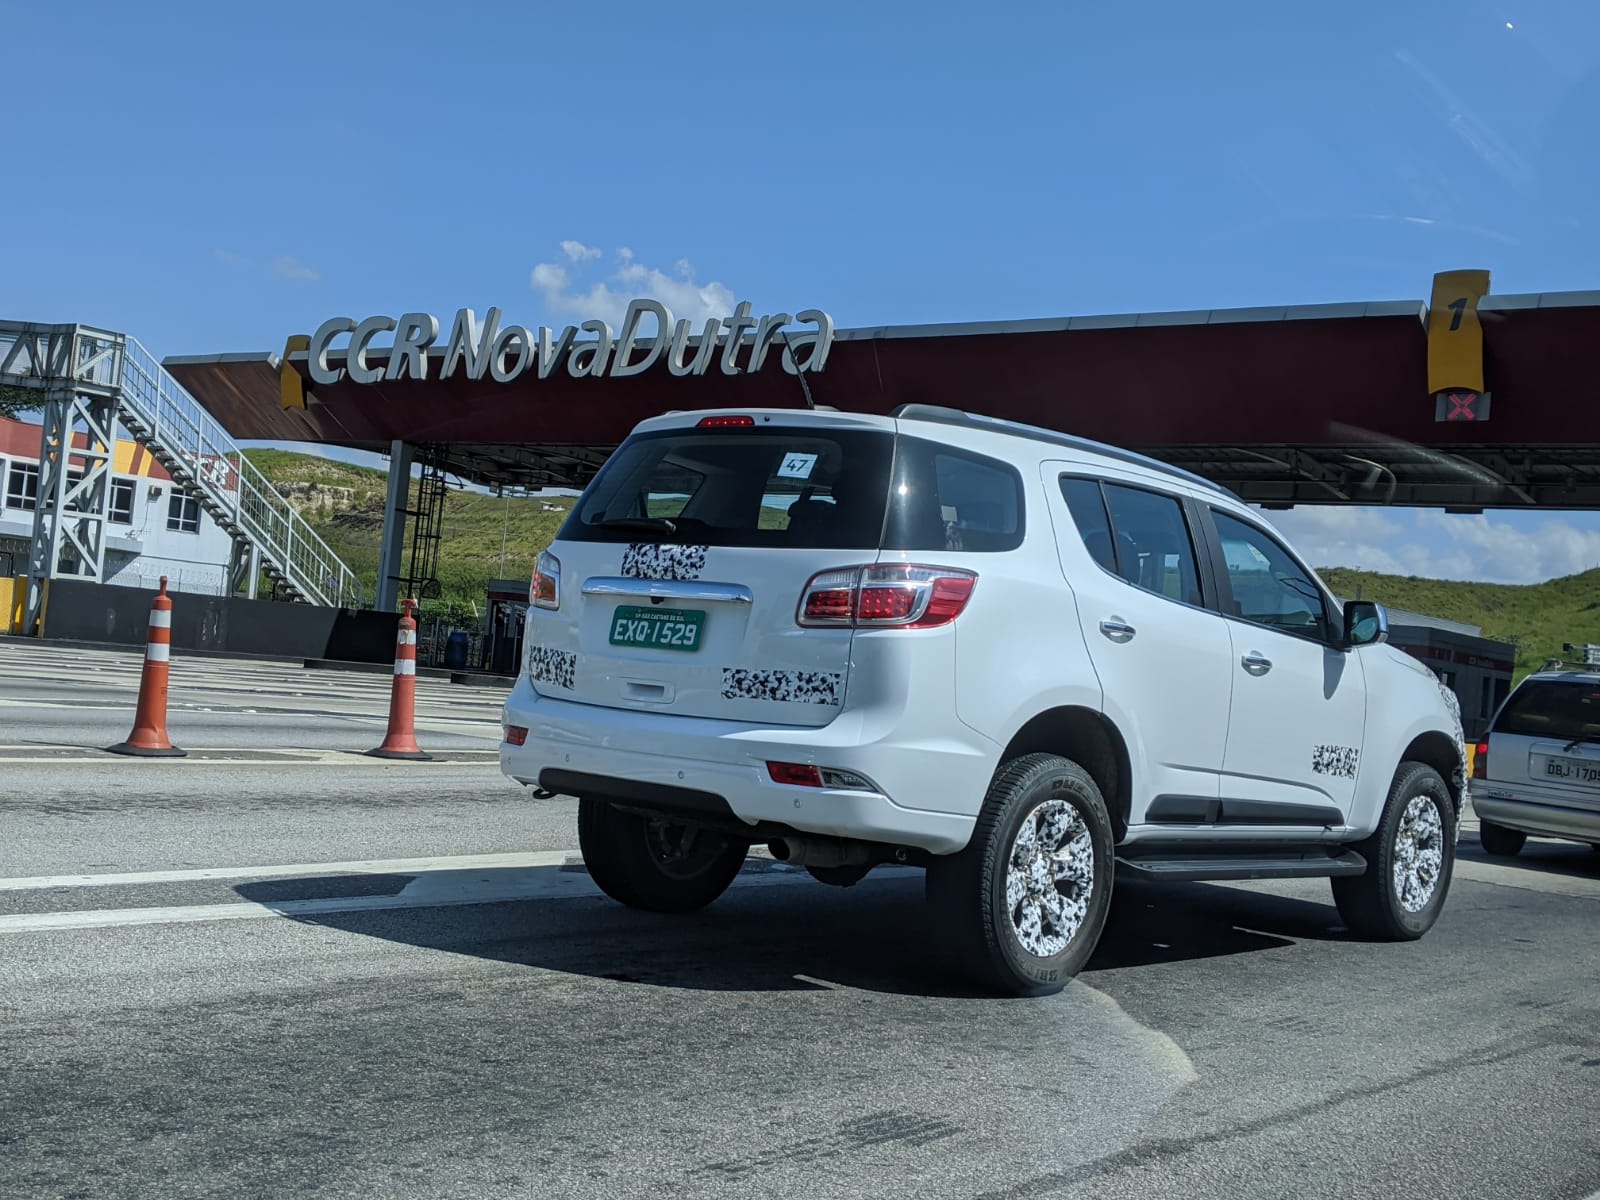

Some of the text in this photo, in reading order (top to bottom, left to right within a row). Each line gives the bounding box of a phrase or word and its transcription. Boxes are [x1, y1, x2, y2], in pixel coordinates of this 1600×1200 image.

[1448, 298, 1468, 331] 1
[308, 299, 834, 384] CCR NovaDutra
[786, 459, 808, 472] 47
